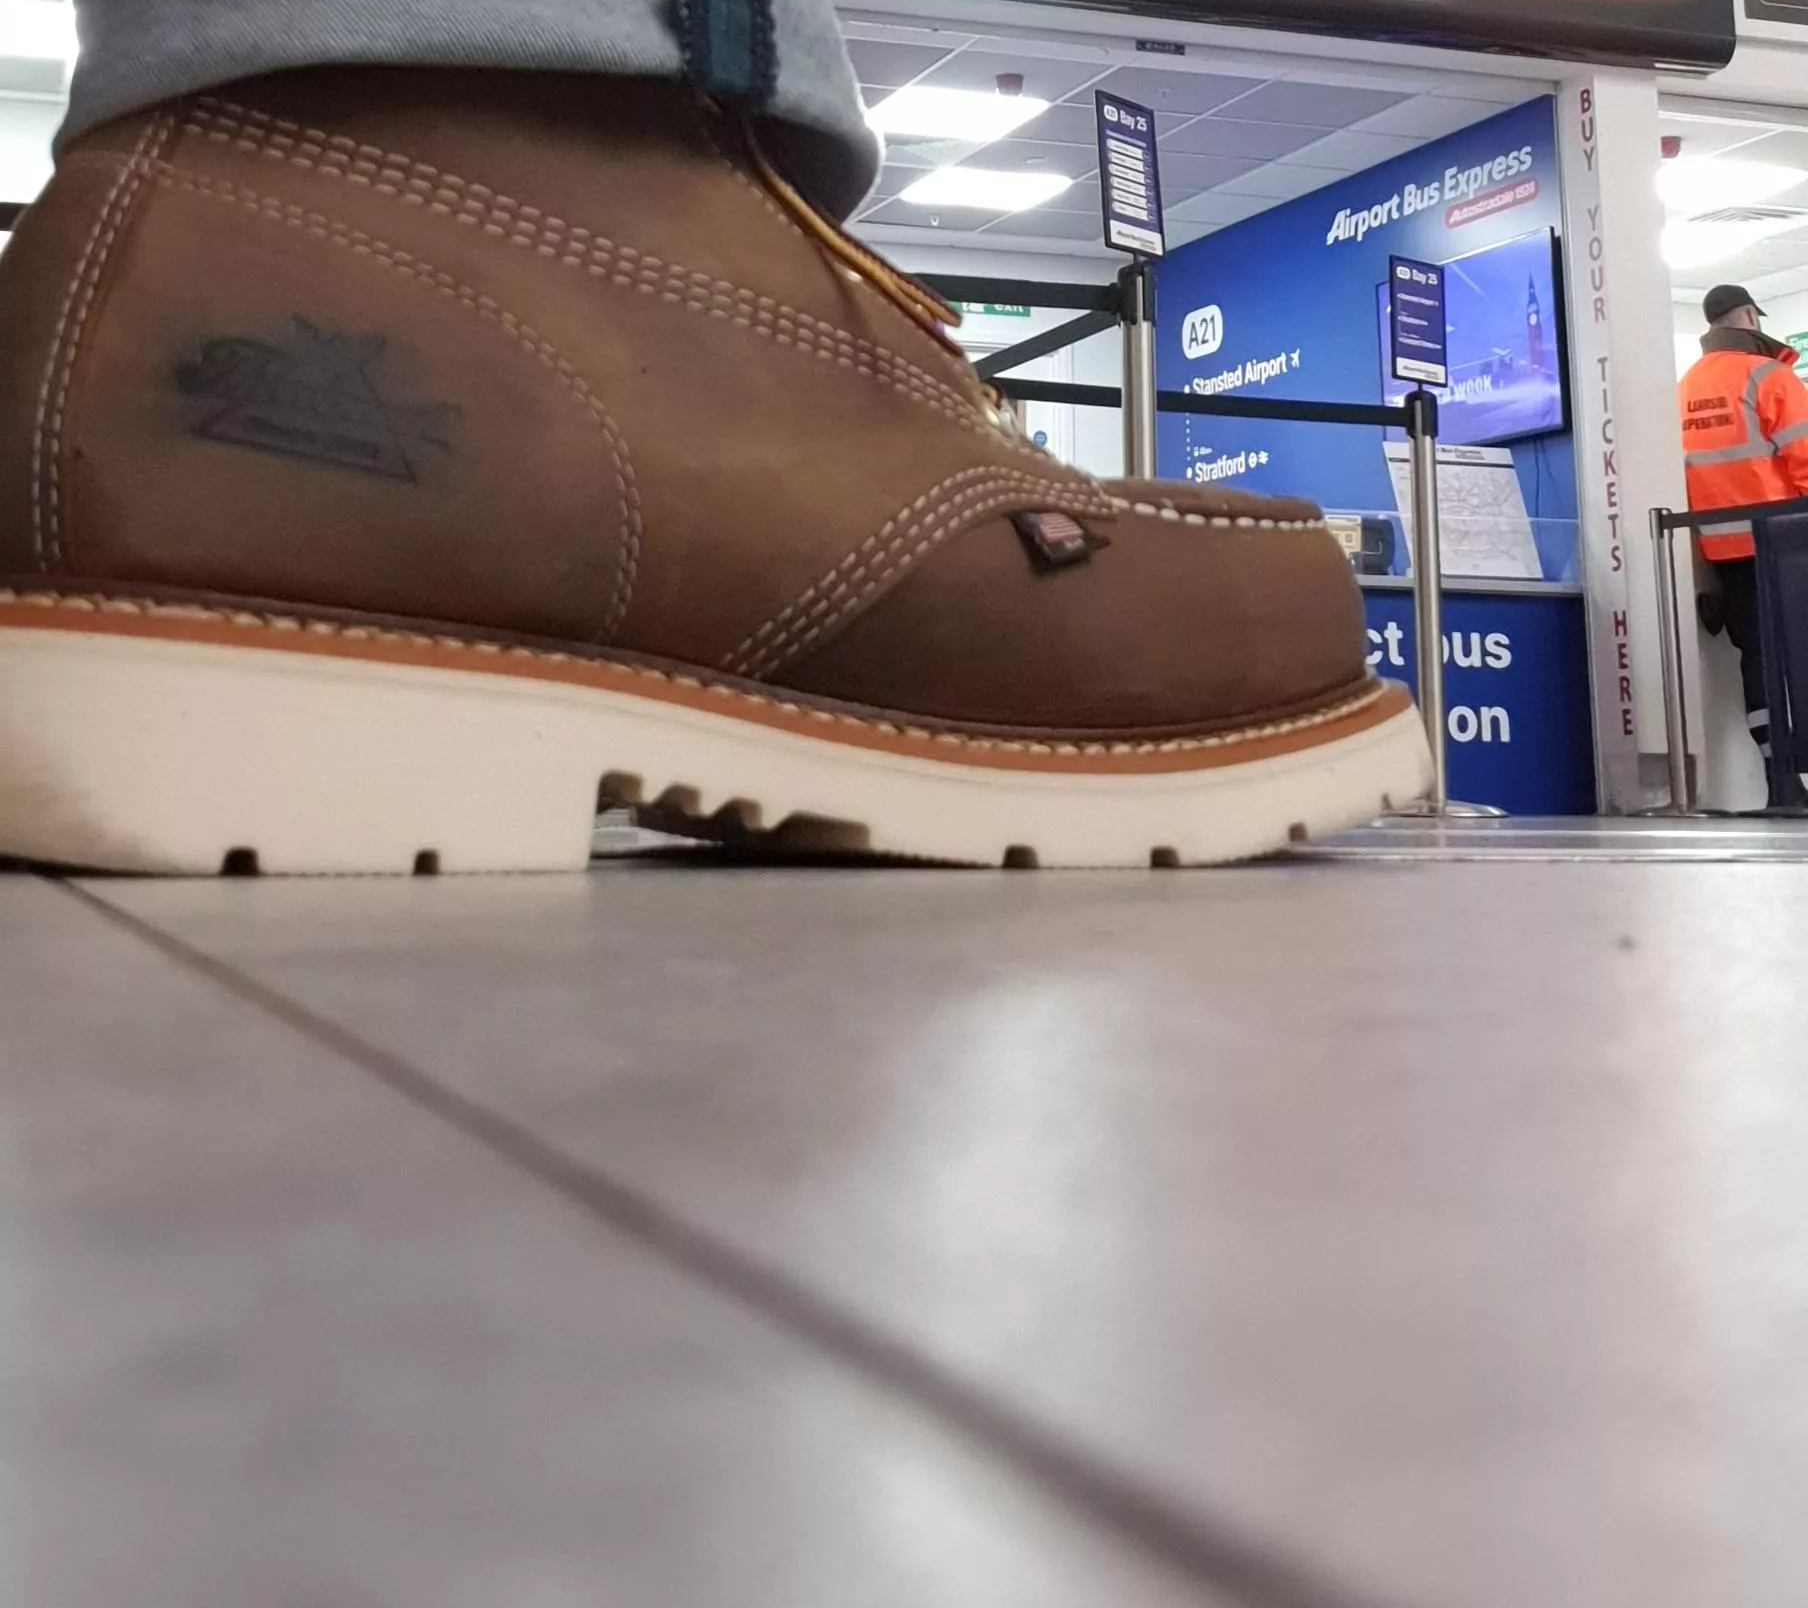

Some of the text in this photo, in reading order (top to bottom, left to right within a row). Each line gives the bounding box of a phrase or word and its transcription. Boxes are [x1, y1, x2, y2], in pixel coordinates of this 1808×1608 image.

[1120, 109, 1135, 130] Bay
[1326, 145, 1533, 245] Airport Bus Express
[1188, 315, 1216, 350] A21
[1193, 352, 1287, 395] Stansted Airport
[1579, 89, 1634, 736] BUY YOUR TICKETS HERE
[1195, 451, 1246, 483] Stratford
[1442, 631, 1512, 669] us
